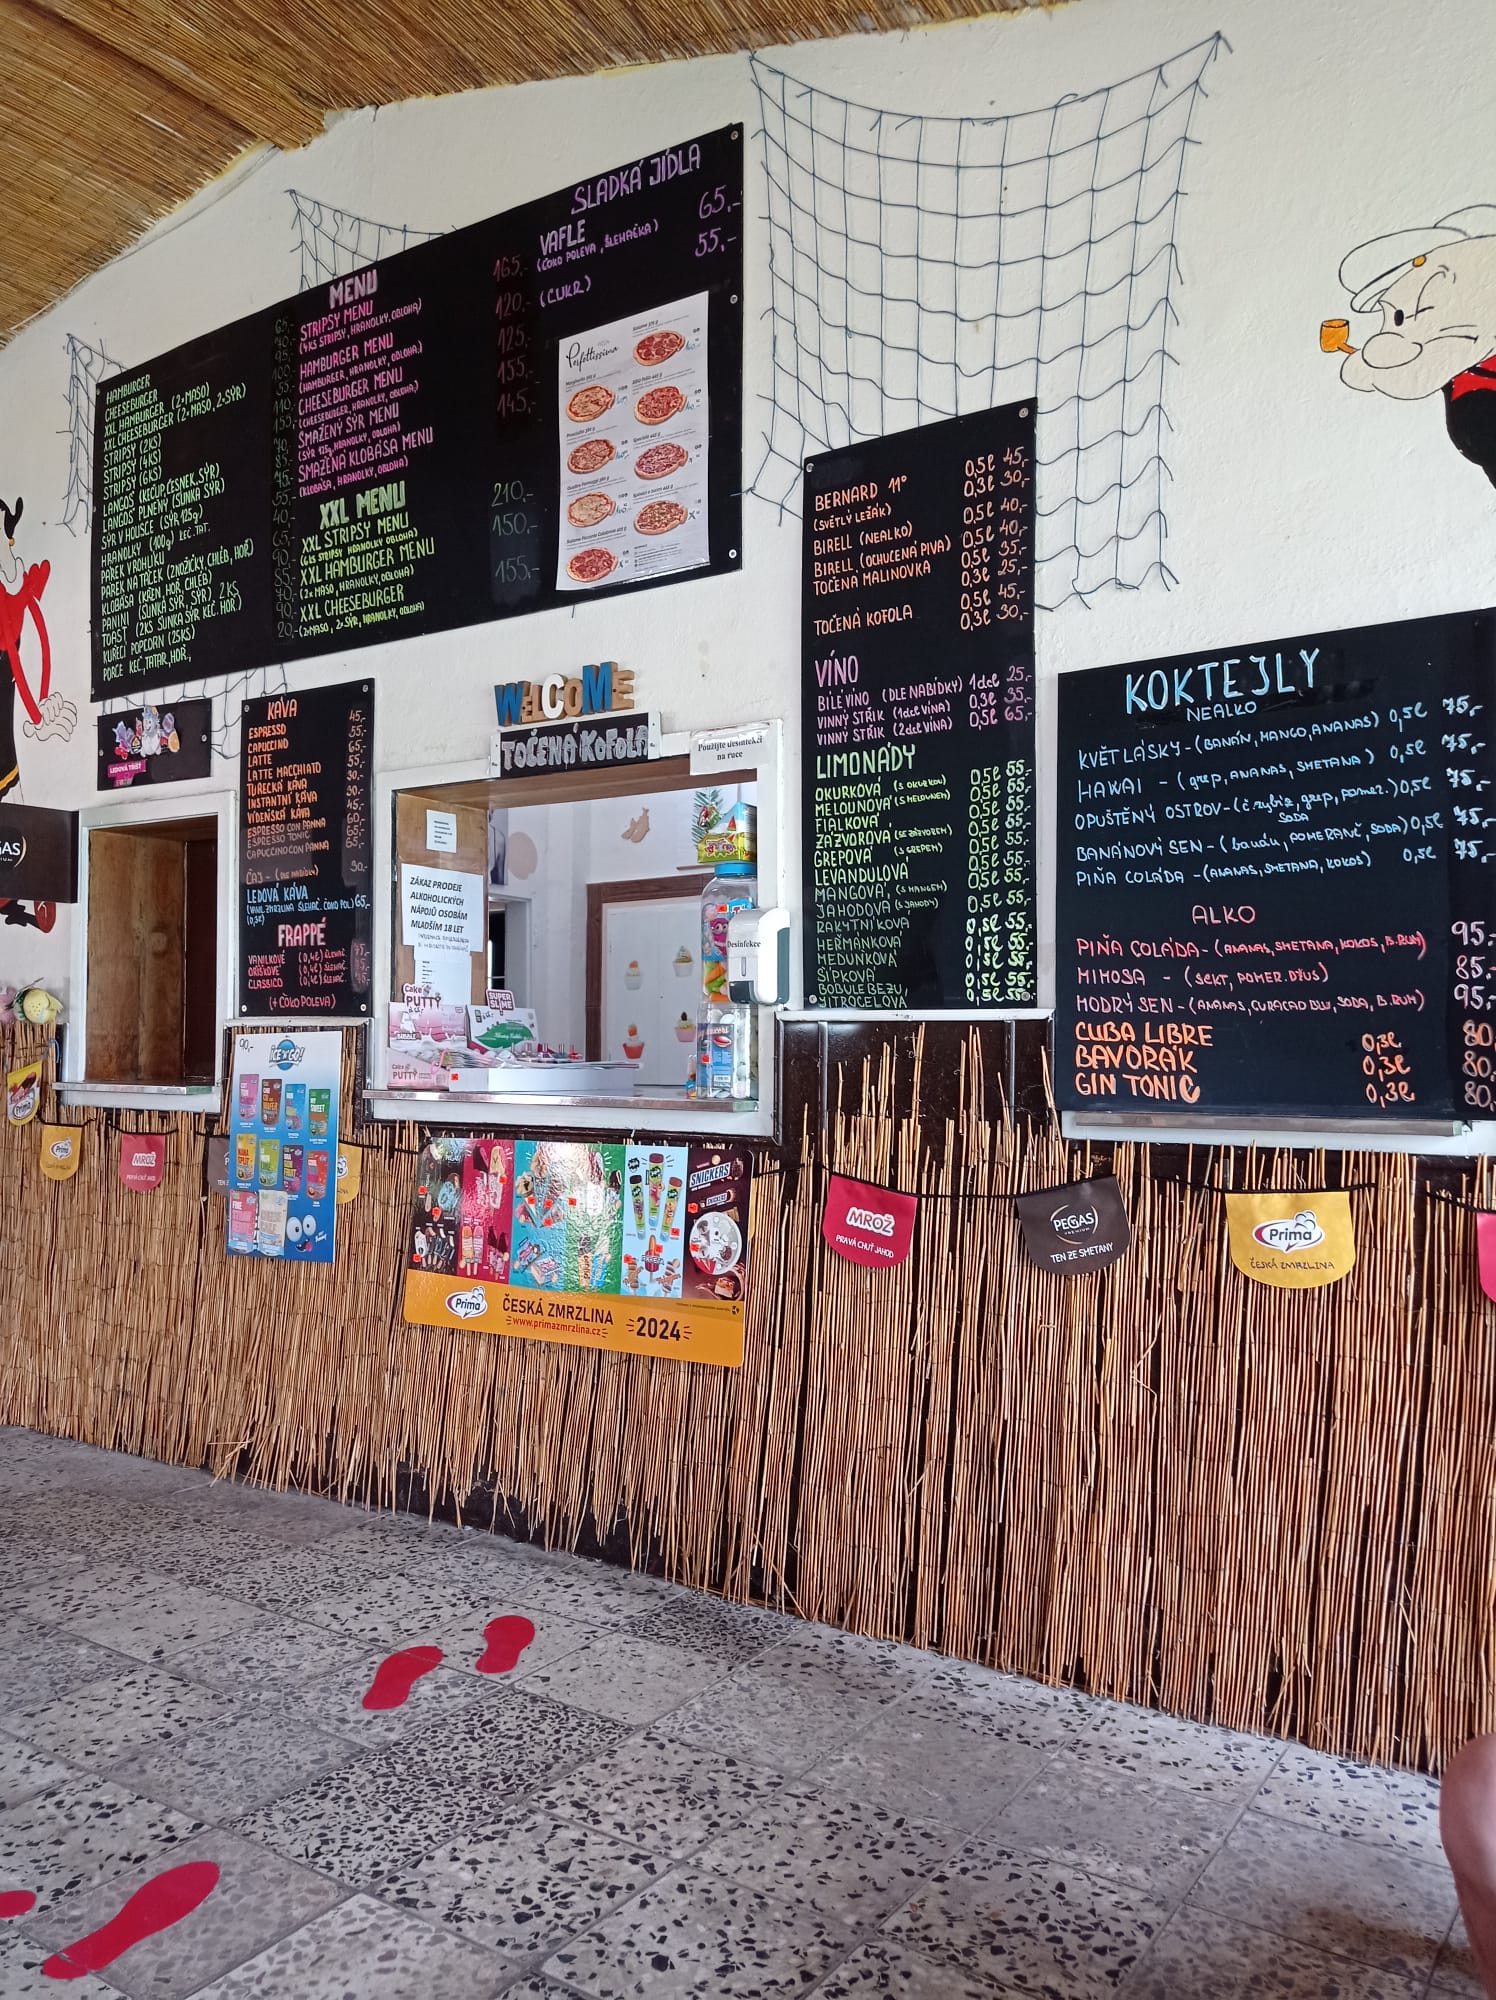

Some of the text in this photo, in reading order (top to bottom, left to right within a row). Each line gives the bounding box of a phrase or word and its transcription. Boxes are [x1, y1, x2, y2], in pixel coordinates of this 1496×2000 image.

[571, 143, 700, 214] SLADKÁ JÍDLA
[540, 184, 742, 255] VAFLE 65,-
[566, 243, 596, 262] POLEVA
[694, 228, 737, 257] 55,-
[329, 269, 378, 309] MENU
[540, 275, 591, 307] (CUKR)
[300, 300, 373, 342] STRIPSY MENU
[300, 332, 394, 381] HAMBURGER MENU
[106, 374, 150, 404] HAMBURGER
[299, 368, 403, 416] CHEESEBURGER MENU
[105, 389, 158, 422] CHEESEBURGER
[119, 402, 164, 431] HAMBURGER
[370, 402, 399, 426] MENU
[118, 412, 174, 446] CHEESEBURGER
[104, 443, 136, 468] STRIPSY
[350, 427, 433, 466] KLOBÁSA MENU
[104, 459, 136, 484] STRIPSY
[816, 483, 877, 511] BERNARD
[1003, 447, 1028, 467] 45,-
[104, 476, 136, 500] STRIPSY
[320, 480, 405, 530] XXL MENU
[813, 470, 1030, 531] (SVĚTLÝ LEŽÁK) 30,-
[302, 512, 408, 553] XXL STRIPSY MENU
[814, 498, 1028, 555] BIRELL (NEALKO) 40,-
[102, 542, 141, 568] HRANOLKY
[300, 537, 435, 587] XXL HAMBURGER MENU
[814, 535, 951, 577] BIRELL (OCHUCENÁ PIVA)
[998, 558, 1028, 576] 25,-
[813, 539, 1027, 596] TOČENÁ MALINOVKA 35,-
[300, 584, 404, 622] XXL CHEESEBURGER
[814, 582, 1025, 636] TOČENÁ KOFOLA 45,-
[996, 604, 1028, 620] 30,-
[102, 611, 129, 632] PANINI
[815, 650, 859, 688] VÍNO
[1126, 648, 1319, 714] KOKTEJLY
[818, 666, 1032, 712] BÍLÉ VÍNO NABÍDKY) 25,-
[268, 696, 297, 720] KÁVA
[817, 707, 885, 730] VINNÝ STŘIK
[1187, 701, 1257, 722] NEALKO
[249, 723, 287, 739] ESPRESSO
[817, 725, 885, 746] VINNÝ STŘIK
[248, 738, 288, 754] CAPUCCINO
[501, 723, 648, 771] TOČENÁ KOFOLA
[717, 751, 742, 760] na ruce
[1079, 746, 1120, 770] KVĚT
[248, 754, 272, 767] LATTE
[248, 762, 321, 782] LATTE MACCHIATO
[816, 742, 916, 779] LIMONÁDY
[247, 779, 283, 796] TURECKÁ
[248, 790, 317, 809] INSTANTNÍ KÁVA
[816, 776, 881, 801] OKURKOVÁ
[1078, 778, 1141, 803] HAWAI
[816, 795, 892, 817] MELOUNOVÁ
[1075, 804, 1155, 830] OPUŠTĚNÝ
[248, 824, 284, 838] ESPRESSO
[816, 812, 880, 833] FIALKOVÁ
[248, 836, 285, 848] ESPRESSO
[1076, 836, 1163, 862] BANÁNOVÝ
[814, 846, 872, 868] GREPOVÁ
[815, 857, 909, 886] LEVANDULOVÁ
[1125, 868, 1184, 884] COLÁDA
[247, 882, 308, 903] LEDOVÁ KÁVA
[410, 876, 462, 892] ZÁKAZ PRODEJE
[815, 882, 887, 903] MANGOVÁ
[410, 891, 464, 906] ALKOHOLICKÝCH
[411, 905, 467, 920] NÁPOJŮ OSOBÁM
[1192, 905, 1255, 925] ALKO
[278, 917, 327, 947] FRAPPÉ
[411, 920, 464, 933] MLADŠÍM 18 LET
[248, 950, 285, 965] VANILKOVÉ
[248, 978, 283, 989] CLASSICO
[1078, 967, 1145, 985] MIMOSA
[405, 985, 422, 993] Cake
[489, 991, 511, 1000] SUPER
[819, 983, 864, 995] BOBULE
[406, 995, 441, 1008] PUTTY
[491, 1000, 512, 1009] SLIME
[1077, 993, 1133, 1013] MODRÝ
[1075, 1022, 1213, 1046] CUBA LIBRE
[1075, 1045, 1197, 1073] BAVORÁK
[393, 1072, 418, 1080] PUTTY
[1075, 1073, 1200, 1104] GIN TONIC
[691, 1167, 730, 1186] SNICKERS
[848, 1208, 895, 1235] MROŽ
[1054, 1212, 1094, 1231] PEGAS
[836, 1234, 894, 1258] PRAVÁ CHUŤ JAHOD
[1270, 1228, 1312, 1242] Prima
[1051, 1242, 1113, 1263] TEN ZE SMETANY
[1250, 1257, 1335, 1270] ČESKÁ ZMRZLINA
[455, 1297, 481, 1312] Prima
[503, 1294, 613, 1325] ČESKÁ ZMRZLINA
[513, 1317, 601, 1337] www.primazmrzlina.cz
[636, 1316, 681, 1342] 2024
